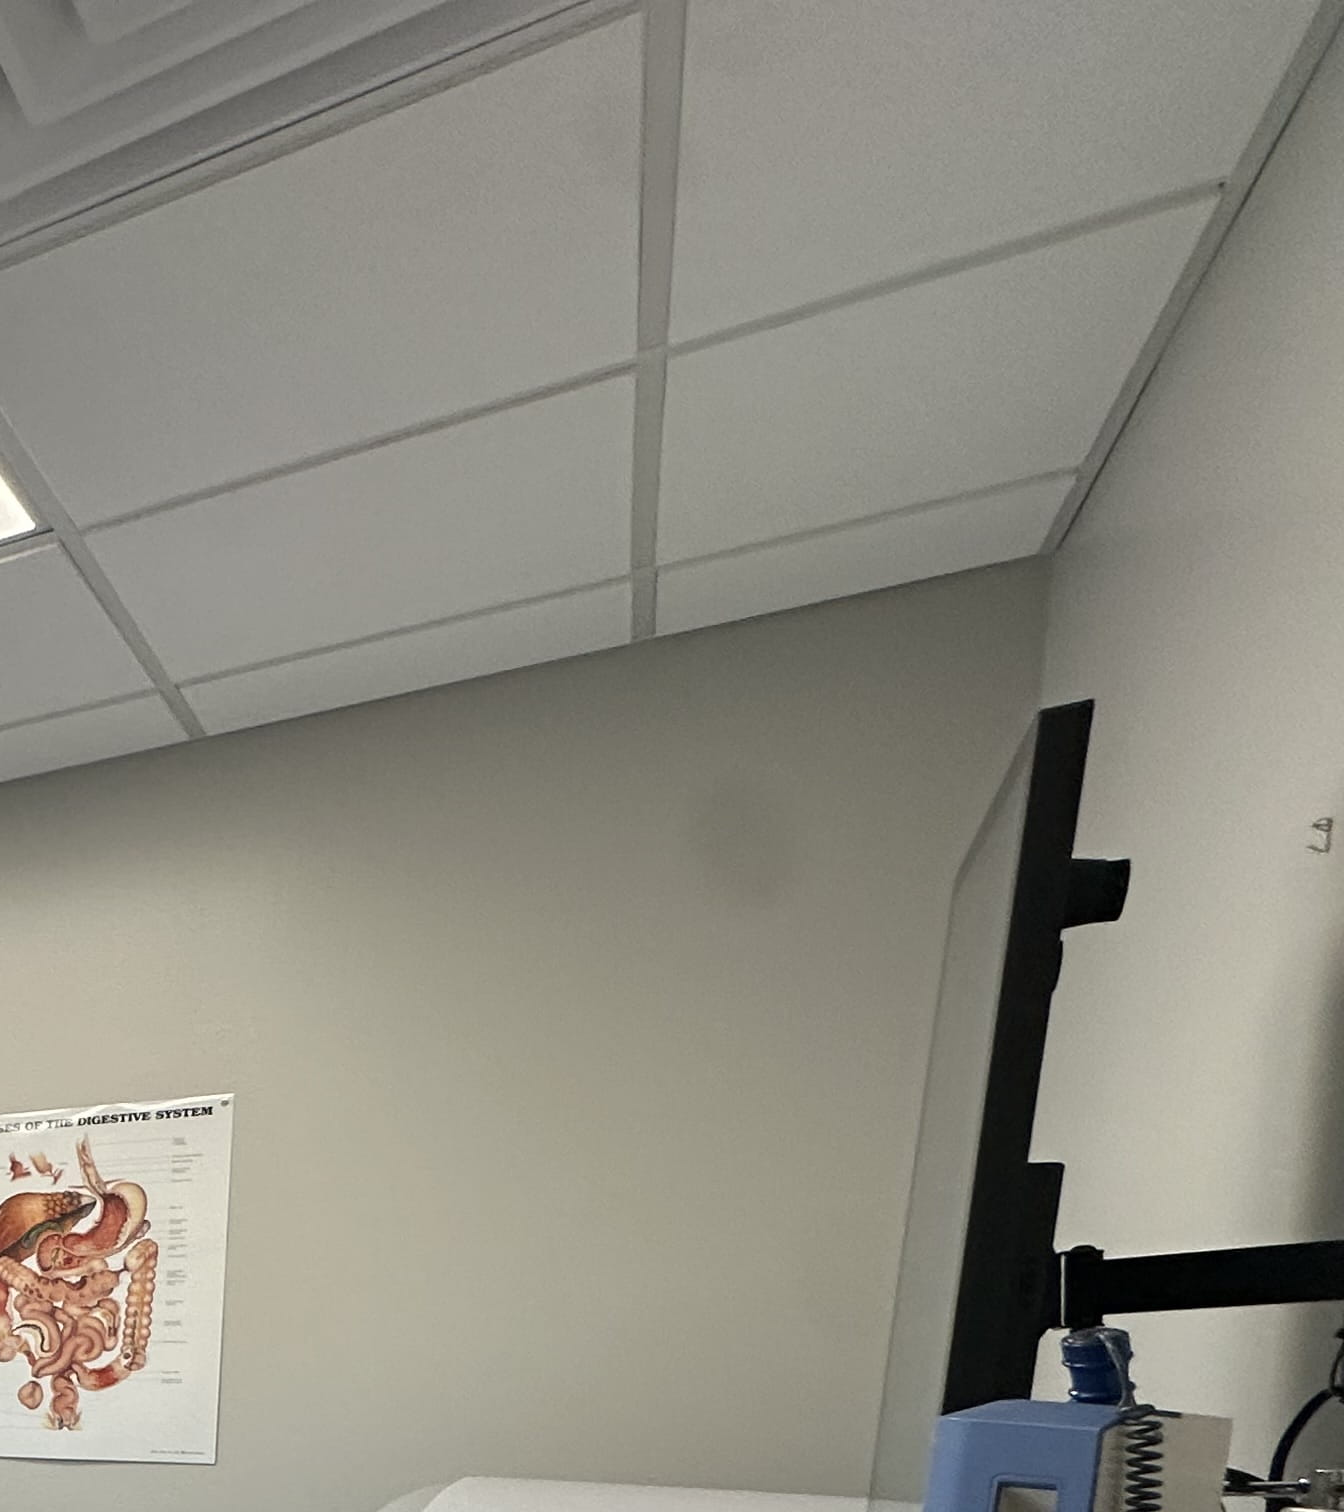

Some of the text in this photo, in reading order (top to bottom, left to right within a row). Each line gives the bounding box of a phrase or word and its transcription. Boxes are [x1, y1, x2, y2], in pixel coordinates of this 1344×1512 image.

[24, 1120, 43, 1131] OF
[46, 1119, 73, 1129] THE
[77, 1111, 151, 1127] DIGESTIVE
[155, 1106, 214, 1120] SYSTEM
